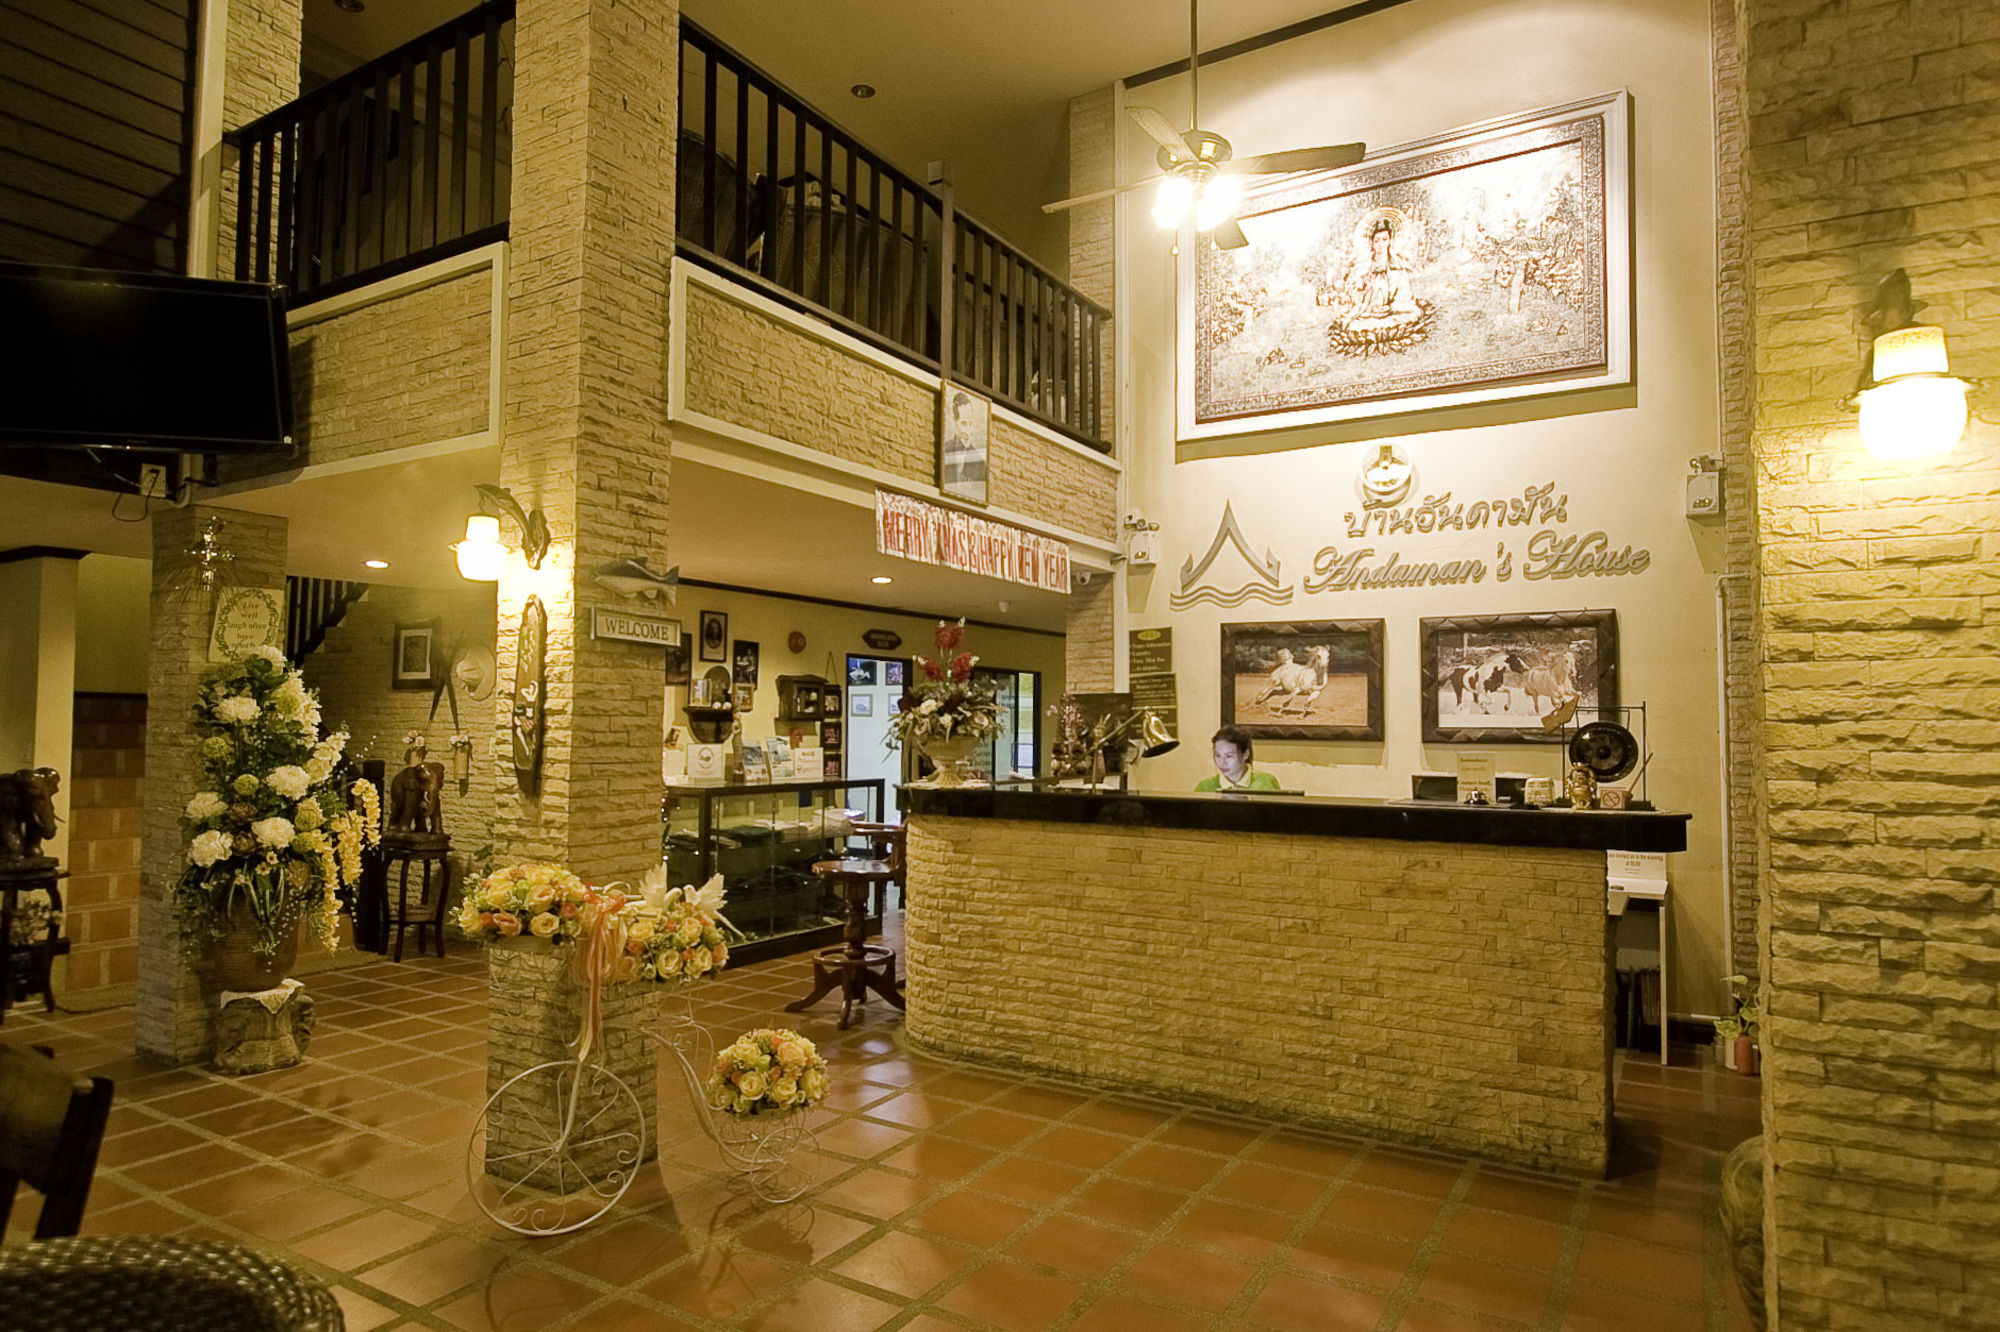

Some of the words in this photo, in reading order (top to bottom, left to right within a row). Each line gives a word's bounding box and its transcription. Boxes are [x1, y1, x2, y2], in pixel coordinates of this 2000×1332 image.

[1344, 481, 1568, 538] บ้านอันดามัน
[883, 508, 929, 560] MERRY
[979, 533, 1013, 581] HAPPY
[1043, 552, 1067, 590] YEAR
[1523, 529, 1651, 580] House
[604, 618, 669, 641] WELCOME
